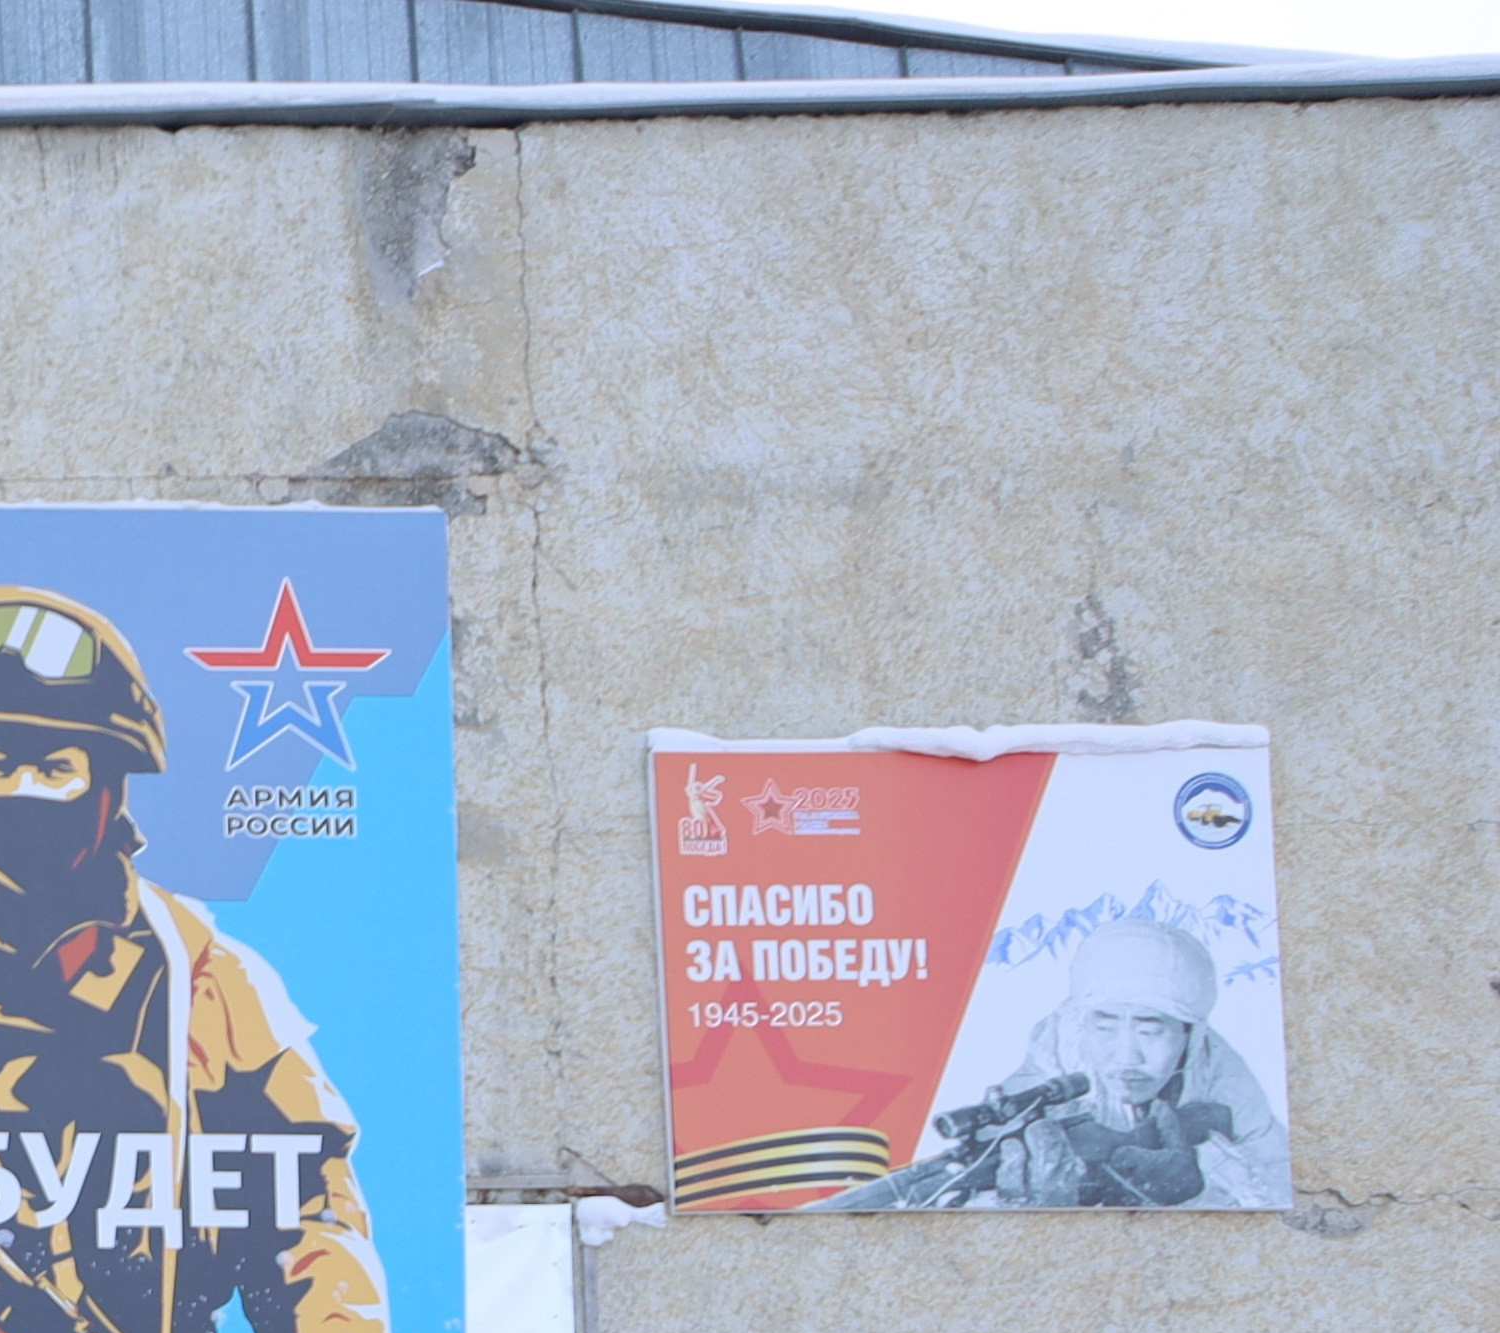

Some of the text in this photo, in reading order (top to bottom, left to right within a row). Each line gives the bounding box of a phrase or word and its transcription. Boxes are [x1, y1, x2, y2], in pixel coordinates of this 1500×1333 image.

[225, 787, 356, 809] АРМИЯ
[225, 815, 356, 837] РОССИИ
[683, 883, 875, 927] СПАСИБО
[685, 938, 929, 987] ЗА ПОБЕДУ!
[688, 1001, 843, 1028] 1945-2025
